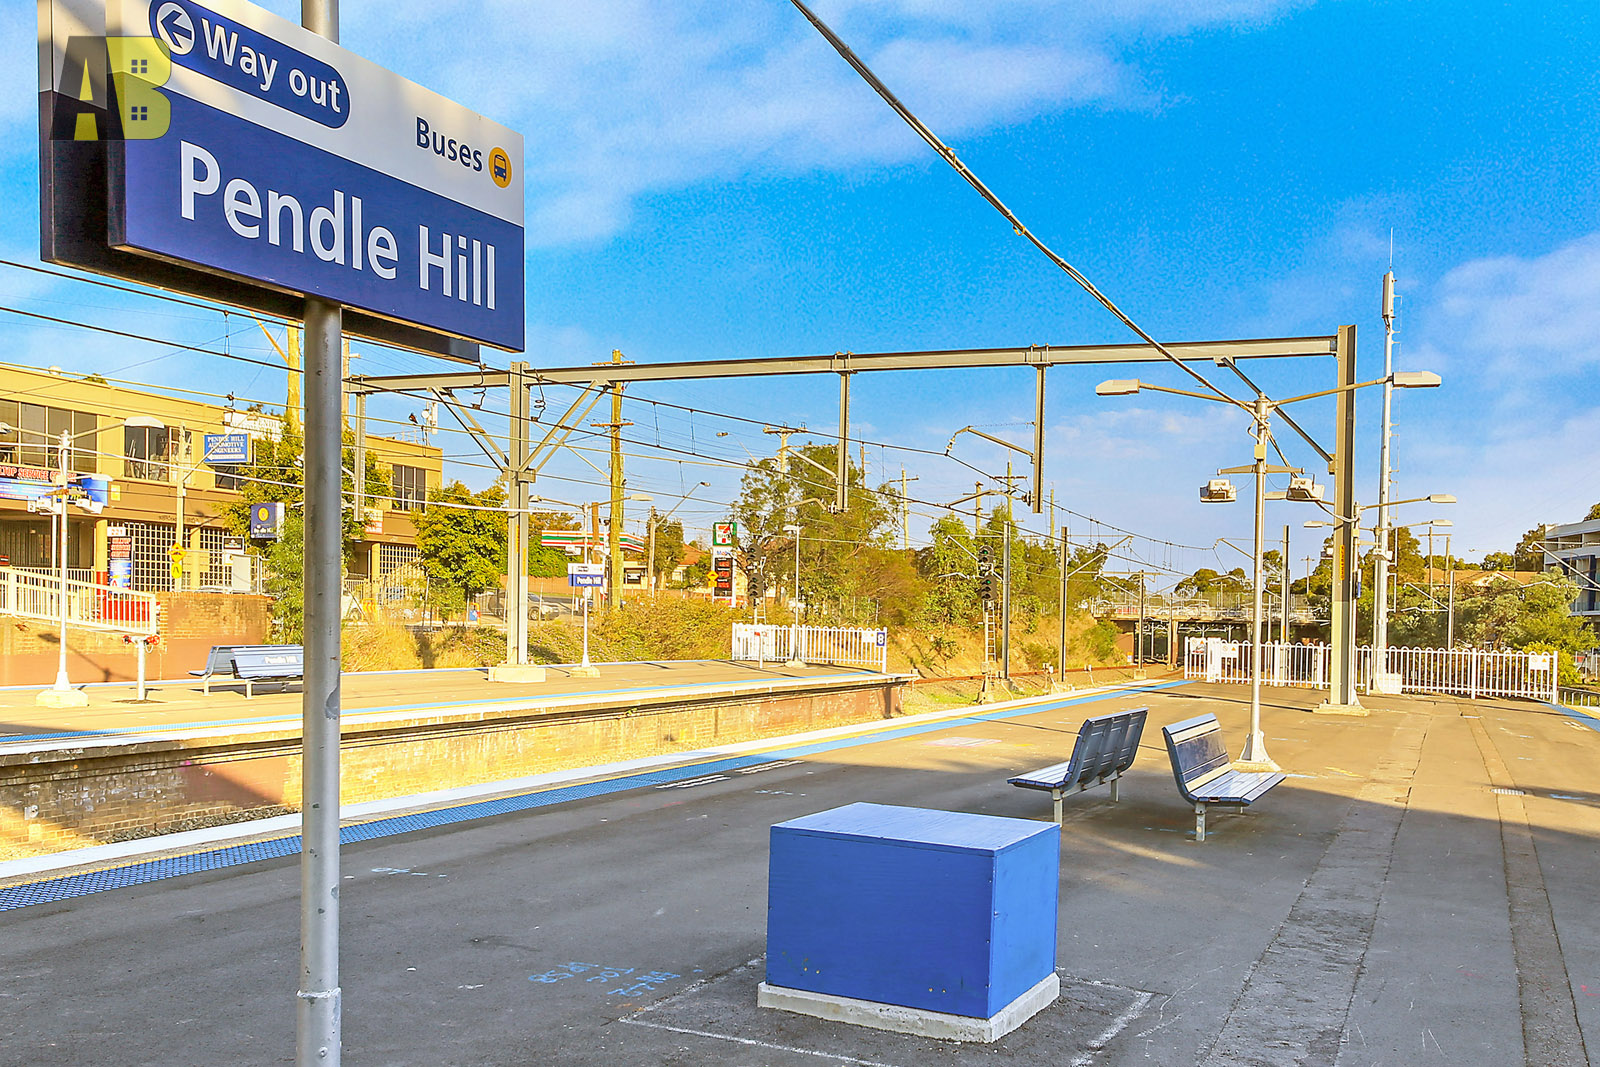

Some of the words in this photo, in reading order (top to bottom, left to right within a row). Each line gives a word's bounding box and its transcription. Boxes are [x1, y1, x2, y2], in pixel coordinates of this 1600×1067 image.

[200, 18, 279, 92] Way
[289, 66, 341, 113] out
[415, 116, 483, 172] Buses
[180, 140, 399, 280] Pendle
[419, 225, 496, 310] Hill
[18, 468, 49, 480] SERVICE
[878, 634, 884, 644] 8
